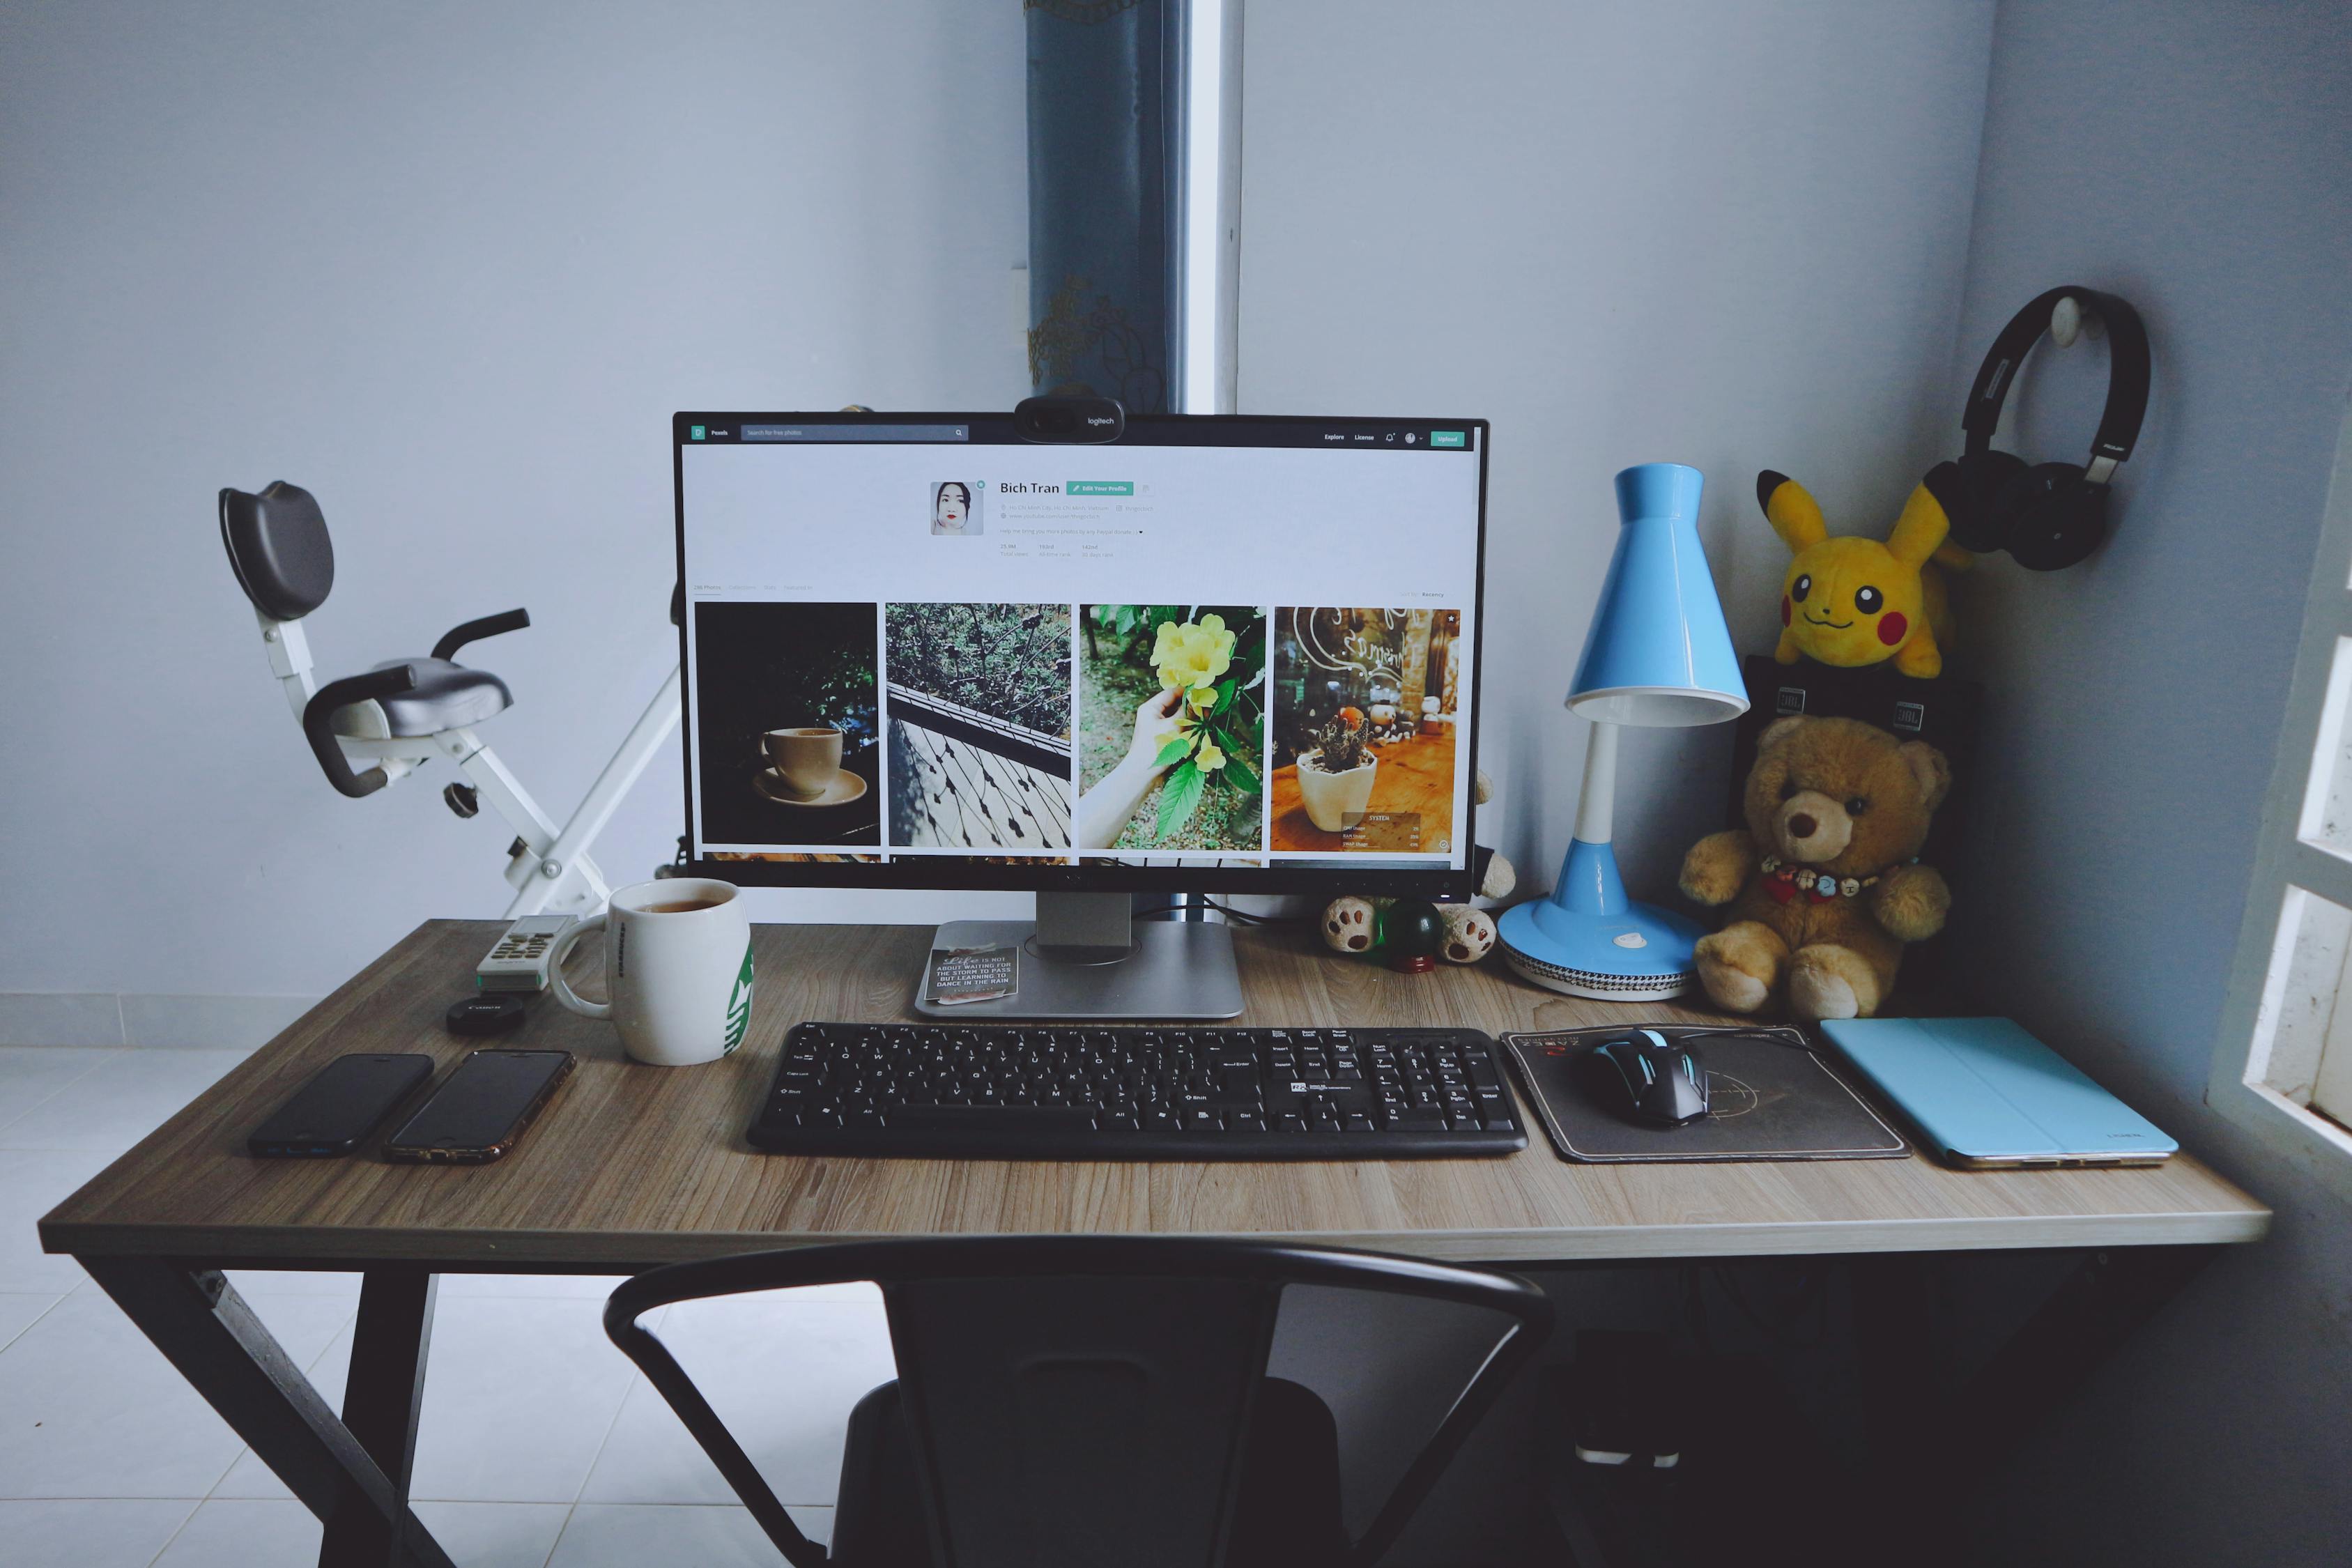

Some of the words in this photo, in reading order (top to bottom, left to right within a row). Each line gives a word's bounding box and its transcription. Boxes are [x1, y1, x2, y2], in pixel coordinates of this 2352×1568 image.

[1088, 417, 1114, 426] logitech
[1001, 482, 1027, 493] Bich
[1031, 483, 1059, 493] Tran
[1781, 695, 1801, 709] JBL
[1898, 709, 1918, 724] JBL
[943, 956, 978, 966] Life
